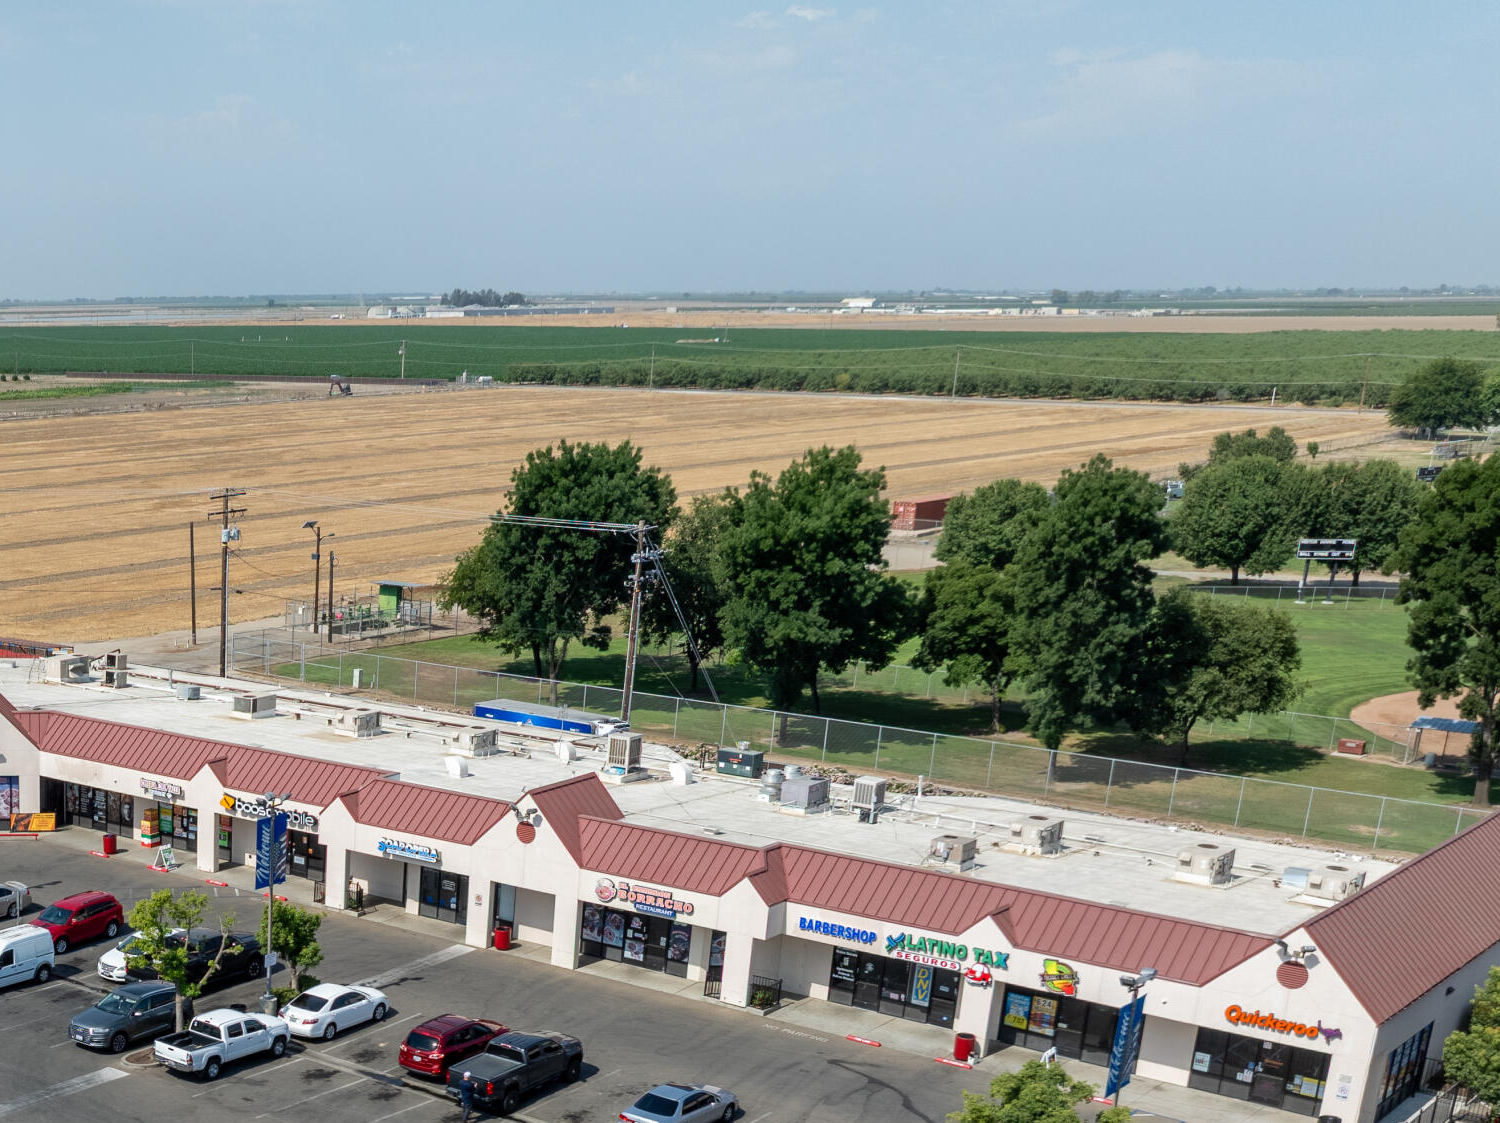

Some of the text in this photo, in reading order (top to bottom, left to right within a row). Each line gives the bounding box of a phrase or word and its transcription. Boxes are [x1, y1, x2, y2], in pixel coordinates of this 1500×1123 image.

[235, 799, 272, 818] boost
[618, 889, 694, 914] BORRACHO
[635, 903, 674, 916] RESTAURANT
[799, 917, 878, 944] BARBERSHOP
[895, 951, 958, 970] SEGUROS
[906, 933, 1010, 970] LATINO TAX
[1224, 1004, 1319, 1039] Quickeroo
[781, 1028, 829, 1043] PARKING
